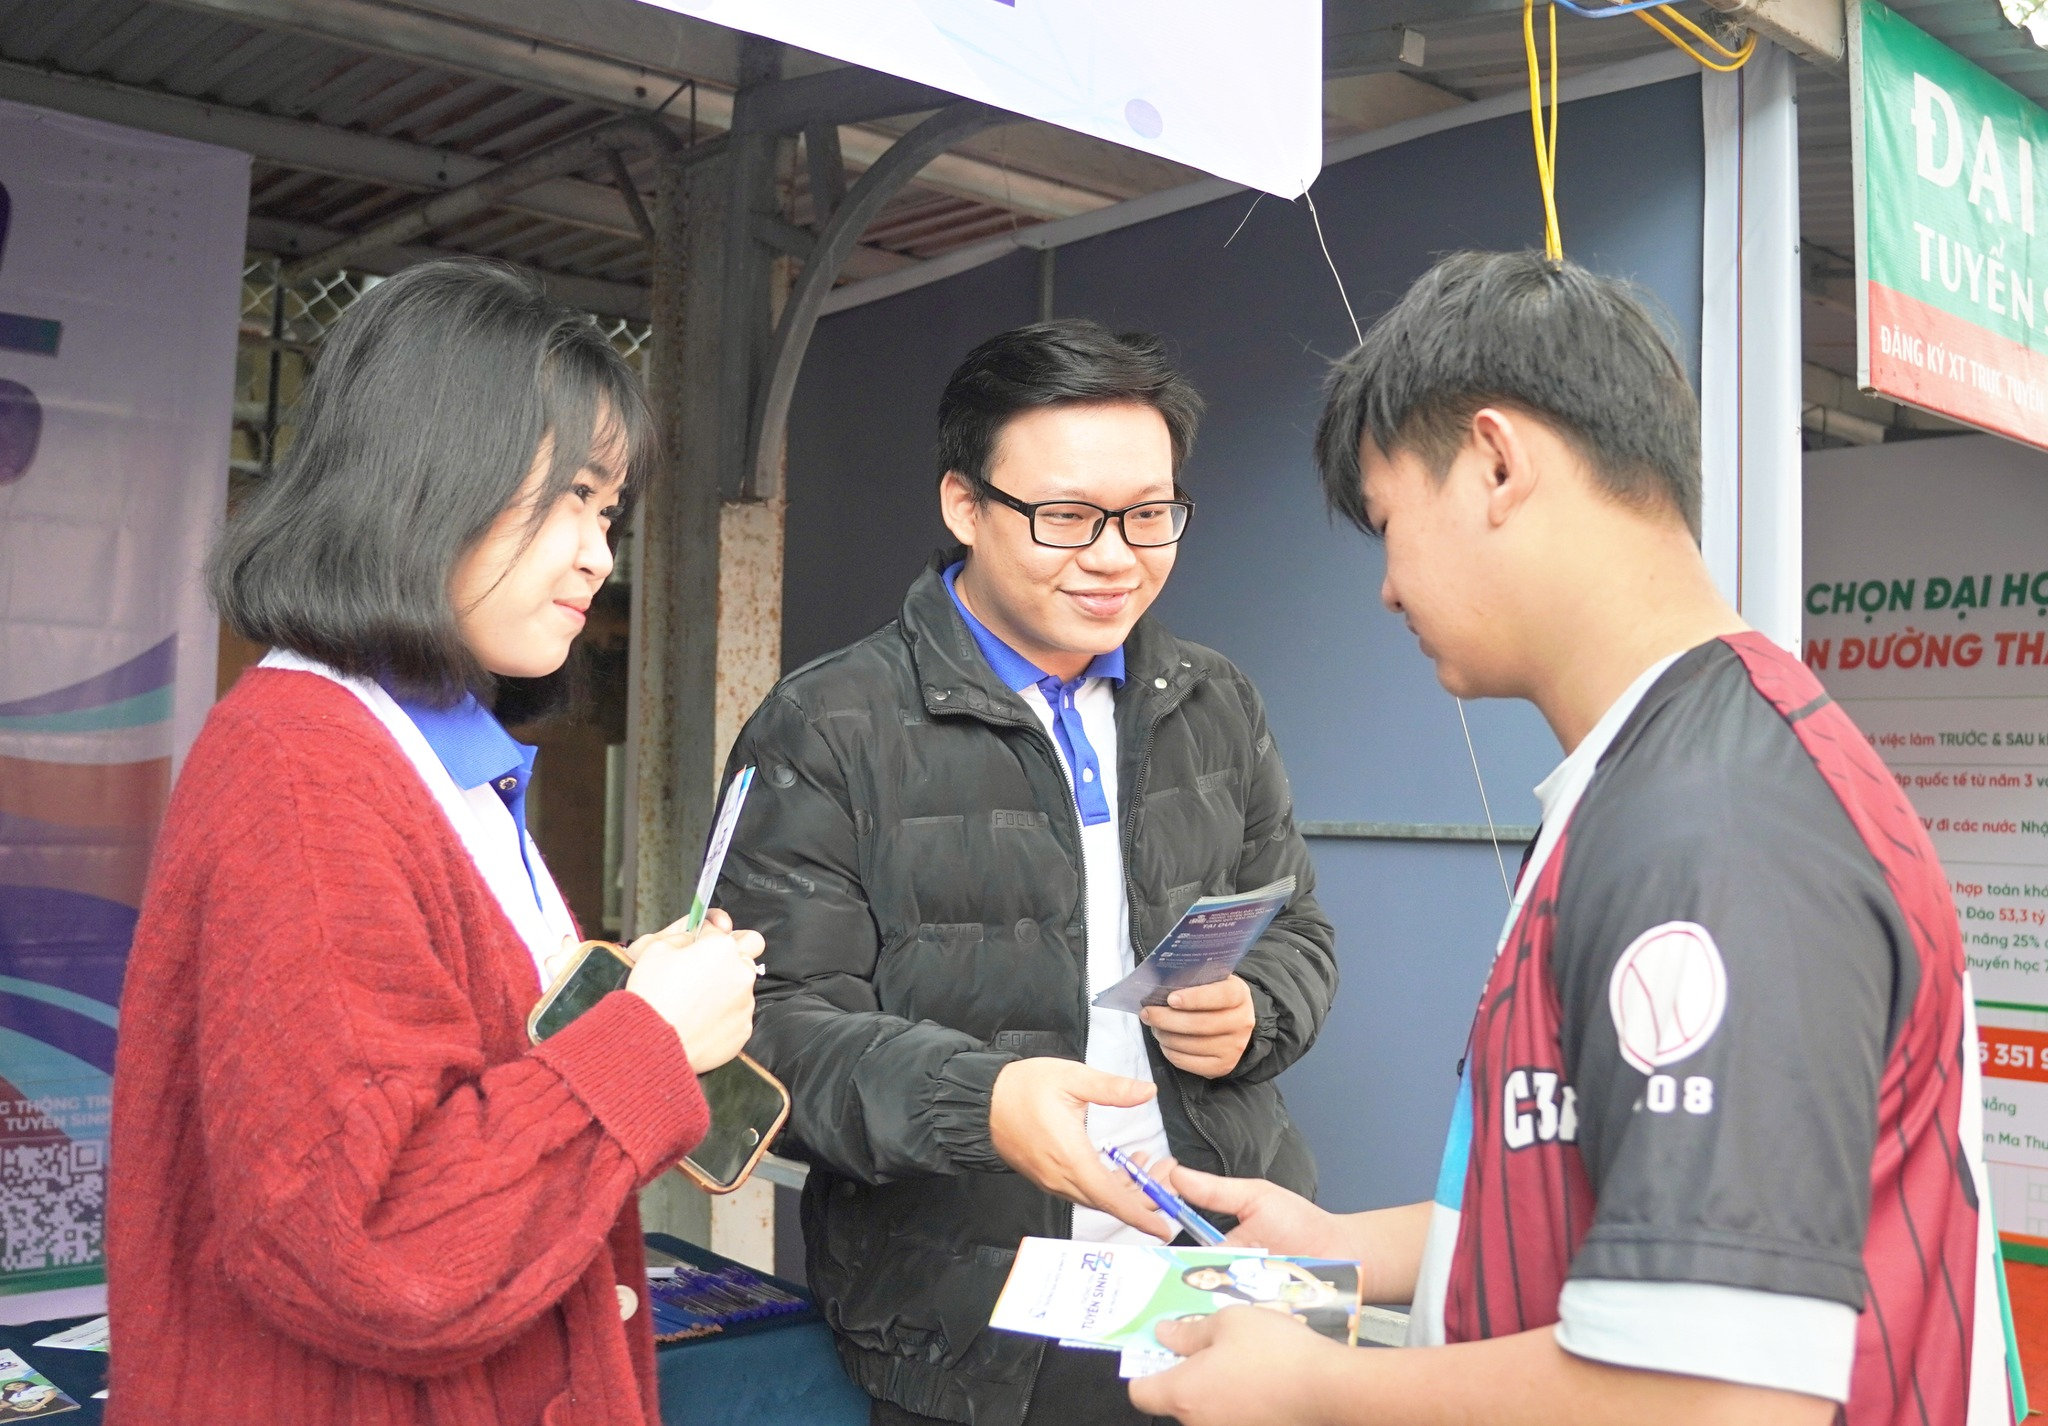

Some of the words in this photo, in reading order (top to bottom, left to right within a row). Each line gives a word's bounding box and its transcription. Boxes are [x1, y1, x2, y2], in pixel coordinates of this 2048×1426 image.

[1911, 72, 2035, 236] ĐẠI
[1913, 221, 2034, 329] TUYỂN
[1880, 324, 1923, 368] ĐĂNG
[1927, 342, 1945, 375] KÝ
[1948, 352, 1966, 383] XT
[1805, 578, 1916, 624] CHỌN
[1924, 574, 1992, 620] ĐẠI
[1838, 626, 1983, 670] ĐƯỜNG
[1994, 631, 2048, 667] TH
[1880, 733, 1906, 748] việc
[1910, 732, 1935, 746] làm
[1938, 729, 1988, 746] TRƯỚC
[1992, 733, 2002, 746] &
[2006, 732, 2034, 746] SAU
[1915, 771, 1948, 792] quốc
[1953, 772, 1967, 787] tế
[1988, 773, 2020, 787] năm
[2023, 773, 2033, 787] 3
[1937, 818, 1948, 832] đi
[1953, 819, 1978, 833] các
[1982, 819, 2017, 834] nước
[1956, 882, 1983, 898] hợp
[1999, 908, 2027, 923] 53,3
[1973, 934, 2008, 949] năng
[2013, 934, 2040, 948] 25%
[2014, 961, 2040, 975] học
[1994, 1043, 2034, 1069] 351
[1999, 1132, 2020, 1147] Ma
[1093, 1272, 1109, 1298] SINH
